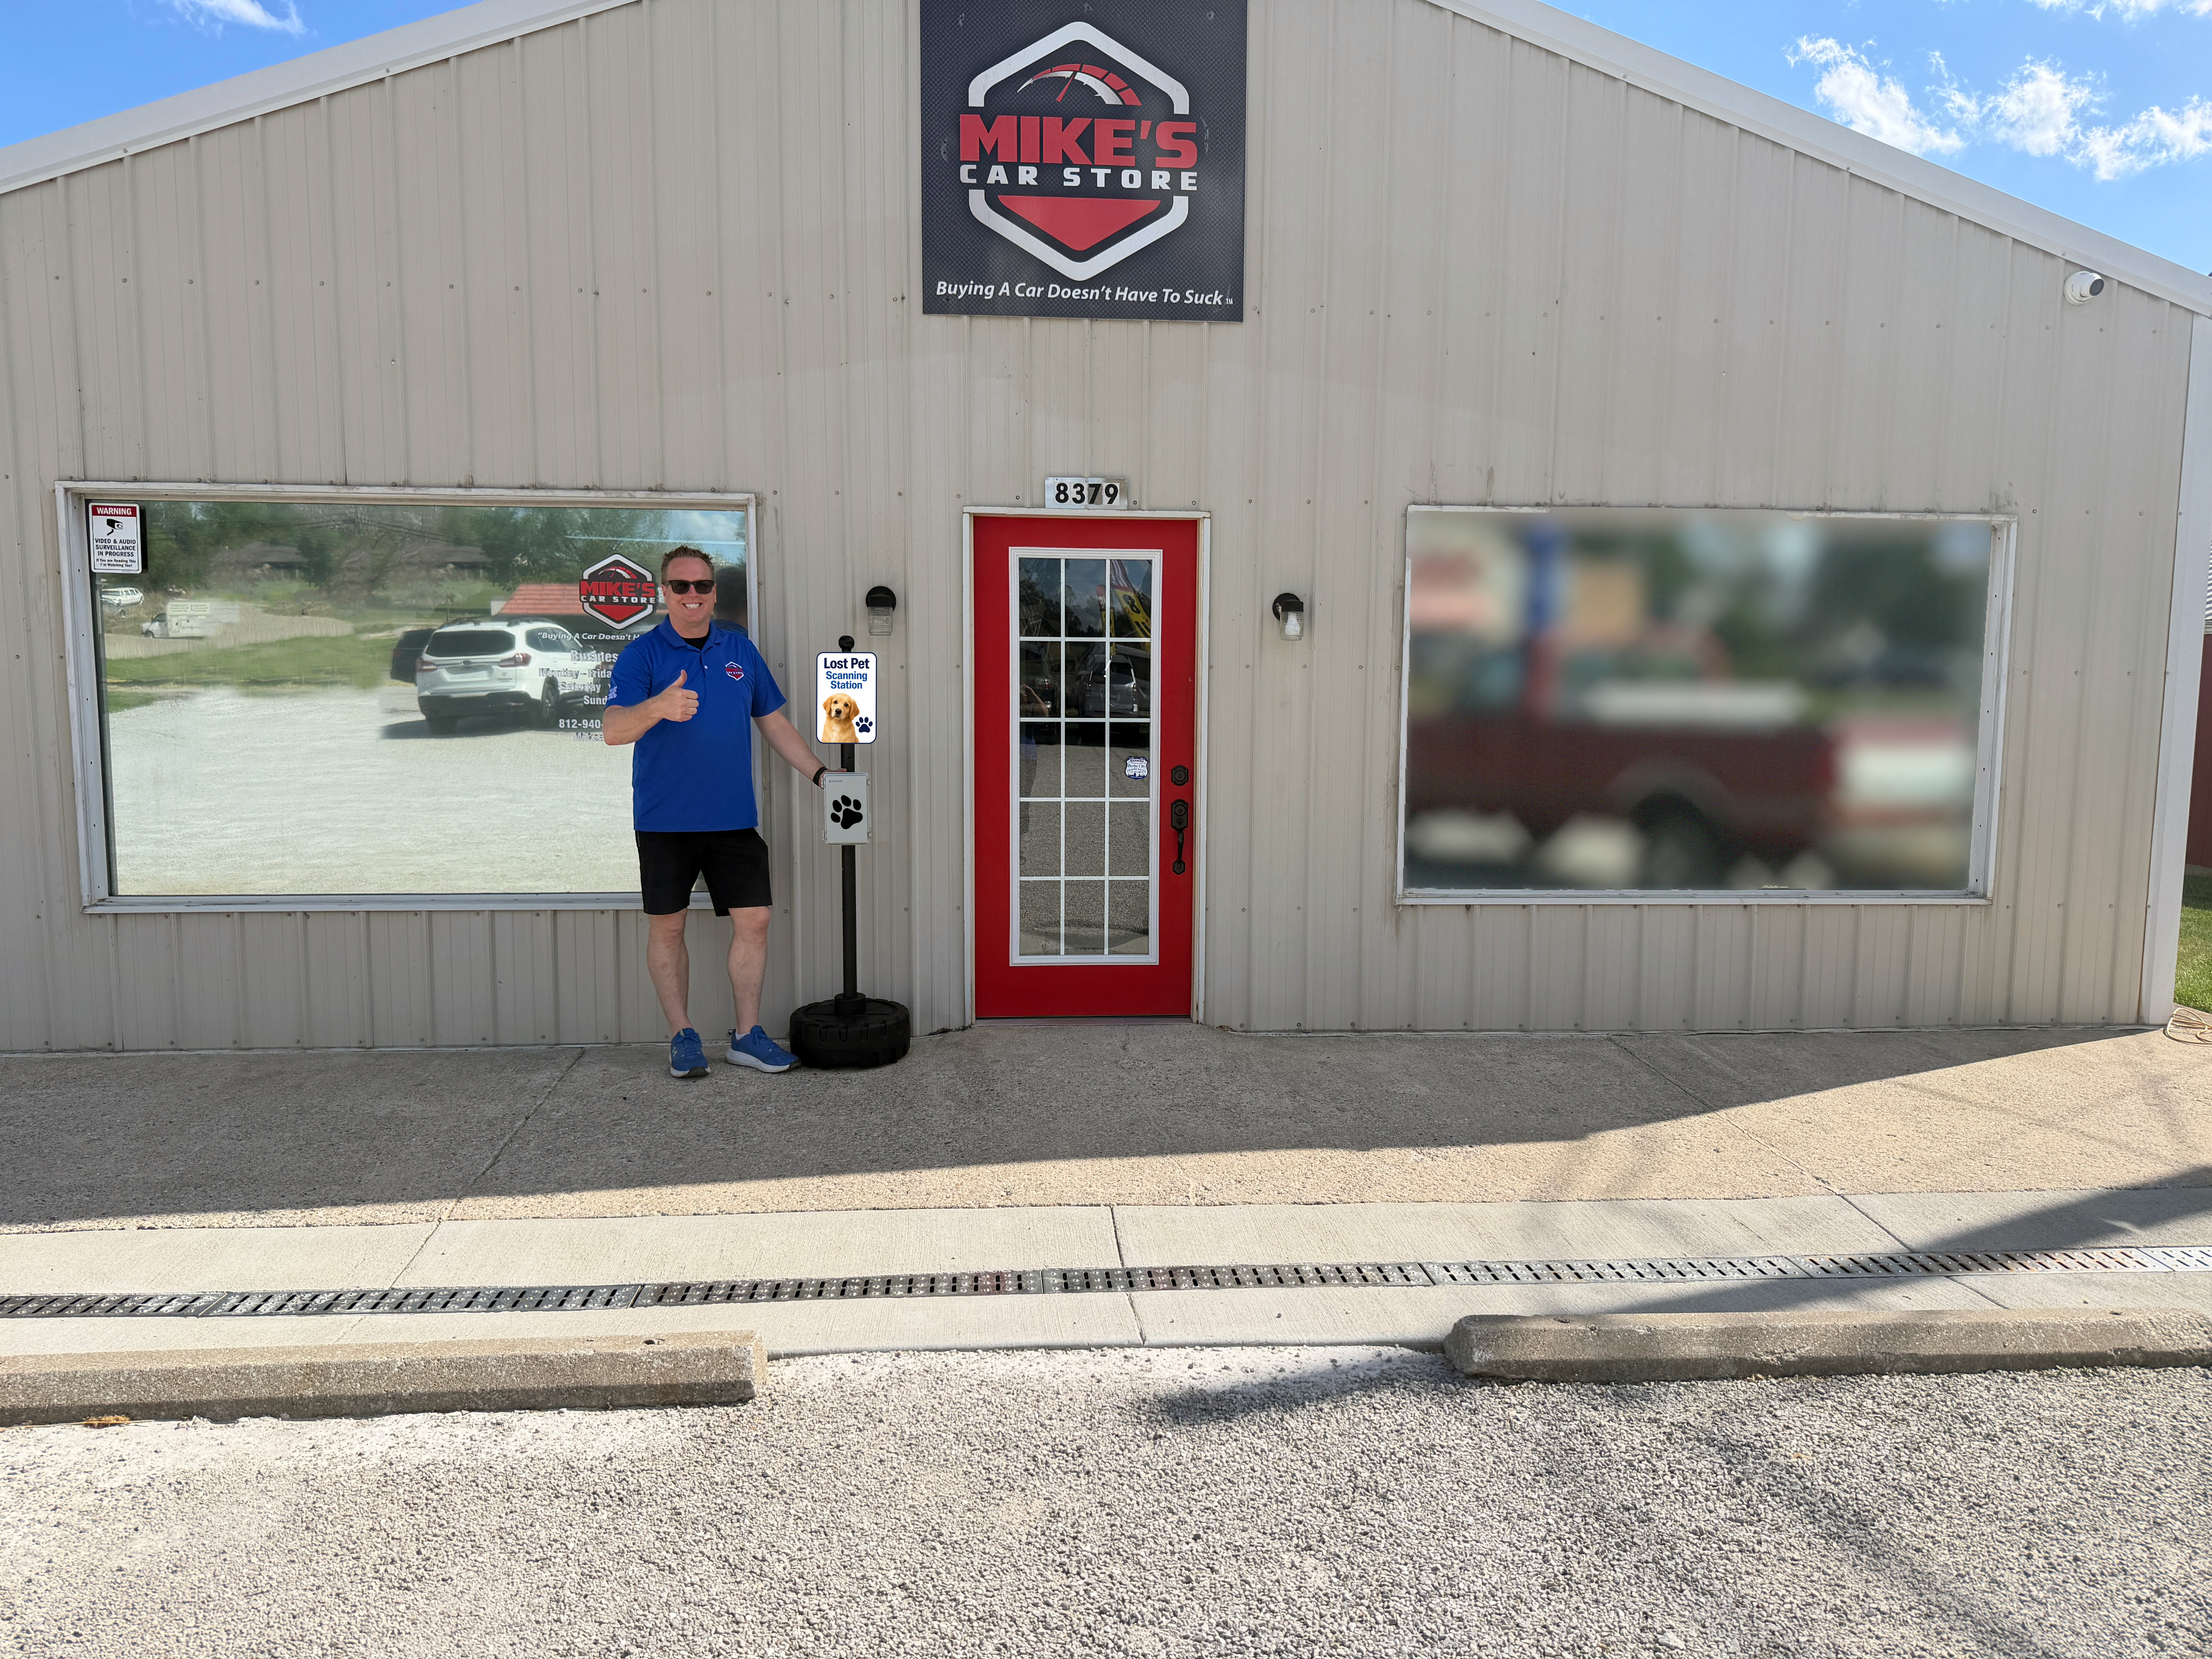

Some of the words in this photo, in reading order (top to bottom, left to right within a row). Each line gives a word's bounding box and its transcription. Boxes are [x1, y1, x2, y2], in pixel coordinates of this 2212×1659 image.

[960, 114, 1198, 169] MIKE'S
[960, 164, 1038, 185] CAR
[1063, 167, 1198, 191] STORE
[936, 281, 994, 300] Buying
[998, 283, 1010, 296] A
[1015, 283, 1044, 298] Car
[1115, 287, 1158, 302] Have
[1162, 289, 1180, 303] To
[1184, 289, 1223, 305] Suck
[1055, 483, 1119, 504] 8379
[96, 507, 132, 515] WARNING
[581, 581, 655, 597] MIKE'S
[571, 650, 618, 663] Busines
[824, 658, 848, 669] Lost
[851, 658, 870, 669] Pet
[588, 668, 612, 678] Frida
[826, 671, 867, 682] Scanning
[831, 680, 862, 689] Station
[584, 695, 608, 705] Sund
